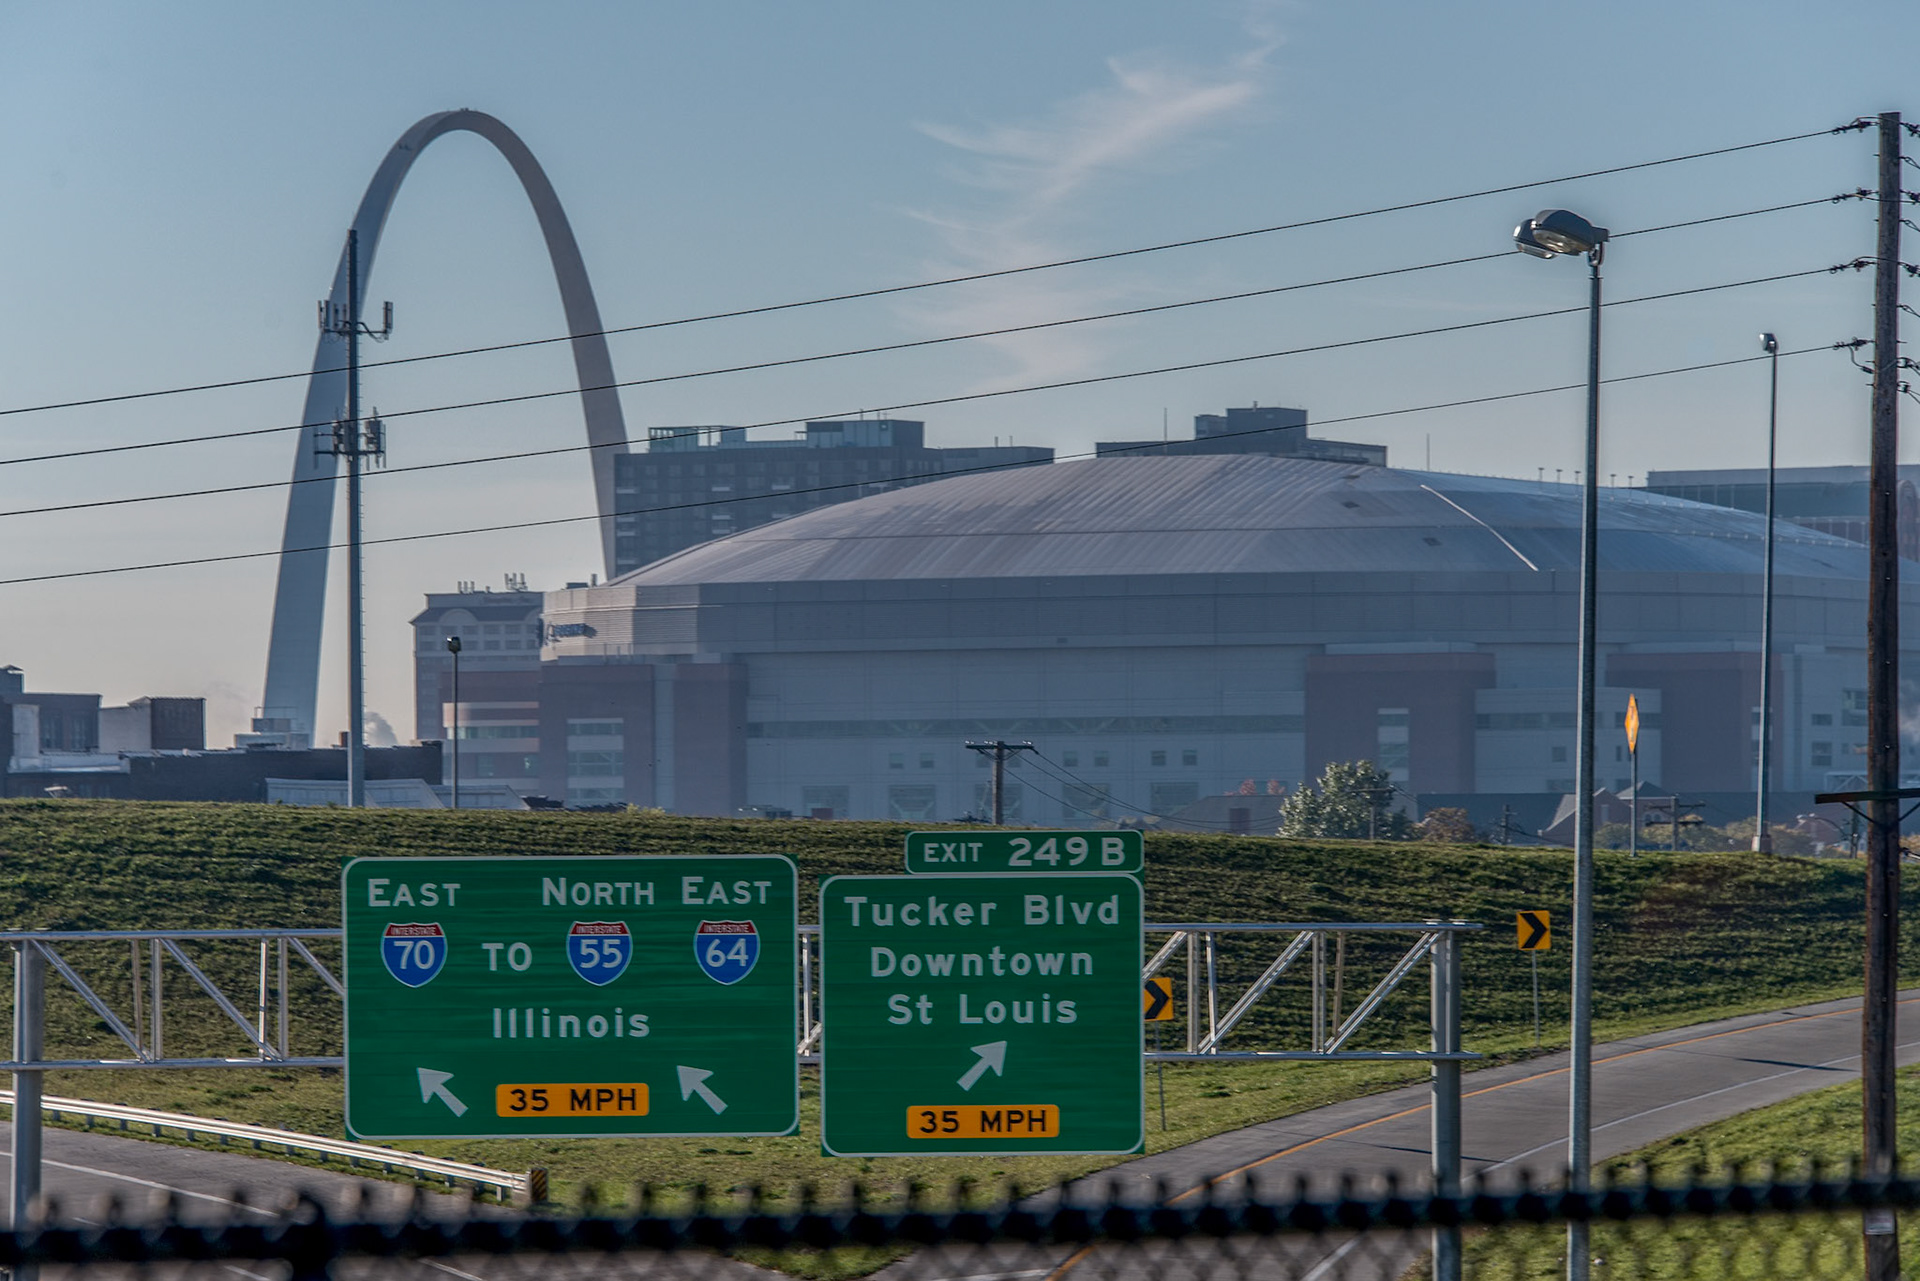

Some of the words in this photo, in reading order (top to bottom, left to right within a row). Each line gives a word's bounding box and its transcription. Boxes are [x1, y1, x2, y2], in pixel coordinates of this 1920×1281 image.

[924, 843, 983, 862] EXIT
[368, 878, 461, 907] EAST
[542, 877, 654, 906] NORTH
[682, 877, 772, 904] EAST
[844, 896, 997, 926] Tucker
[1024, 895, 1119, 925] Blvd
[390, 927, 436, 936] INTERSTATE
[576, 925, 622, 934] INTERSTATE
[703, 924, 749, 933] INTERSTATE
[394, 940, 435, 969] 70
[482, 942, 532, 971] TO
[580, 939, 623, 968] 55
[706, 938, 749, 967] 64
[871, 946, 1093, 977] Downtown
[493, 1008, 650, 1038] Illinois
[888, 994, 933, 1024] St
[959, 994, 1077, 1024] Louis
[509, 1089, 549, 1112] 35
[570, 1089, 637, 1111] MPH
[920, 1111, 959, 1133] 35
[981, 1110, 1047, 1132] MPH
